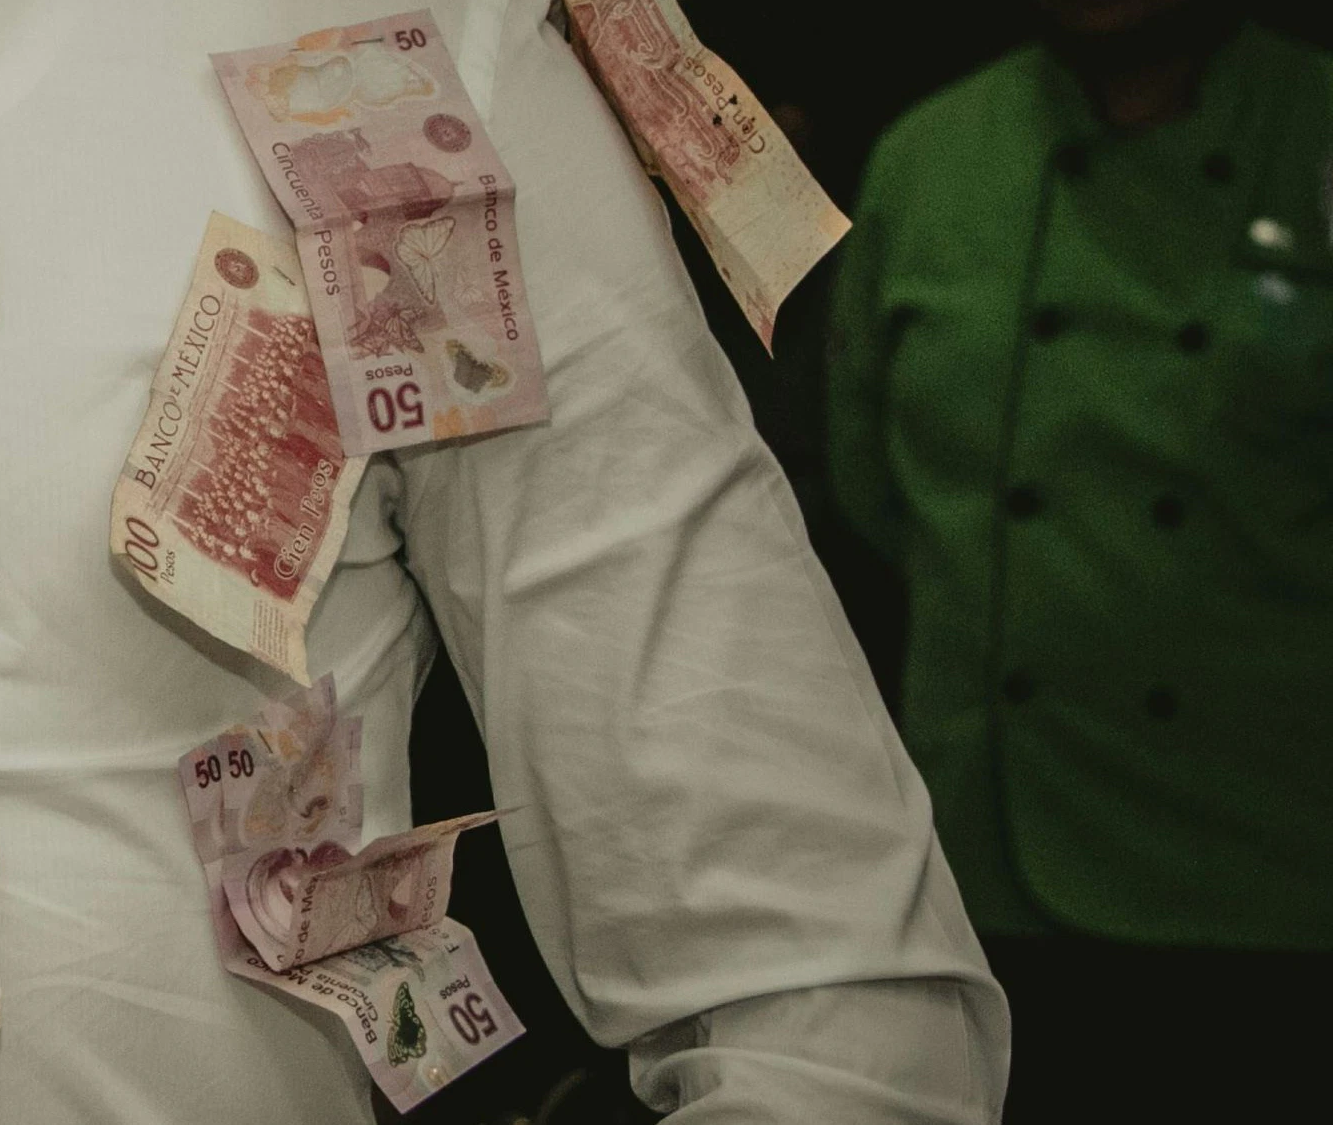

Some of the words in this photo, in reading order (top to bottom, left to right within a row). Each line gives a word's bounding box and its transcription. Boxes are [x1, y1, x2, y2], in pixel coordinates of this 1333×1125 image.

[395, 28, 427, 52] 50
[271, 141, 324, 221] Cincuenta
[313, 228, 341, 297] Pesos
[478, 173, 499, 232] Banco
[487, 236, 503, 264] de
[492, 268, 520, 342] México
[364, 361, 414, 380] Pesos
[366, 380, 426, 434] 50
[135, 393, 184, 492] BANCO
[123, 515, 161, 583] 100
[159, 549, 176, 585] Pesos
[274, 524, 317, 581] Cien
[194, 754, 221, 789] 50
[227, 748, 255, 779] 50
[310, 979, 334, 996] de
[316, 972, 379, 1023] Cincuenta
[438, 974, 472, 1001] Pesos
[336, 992, 378, 1045] Banco
[448, 992, 499, 1047] 50
